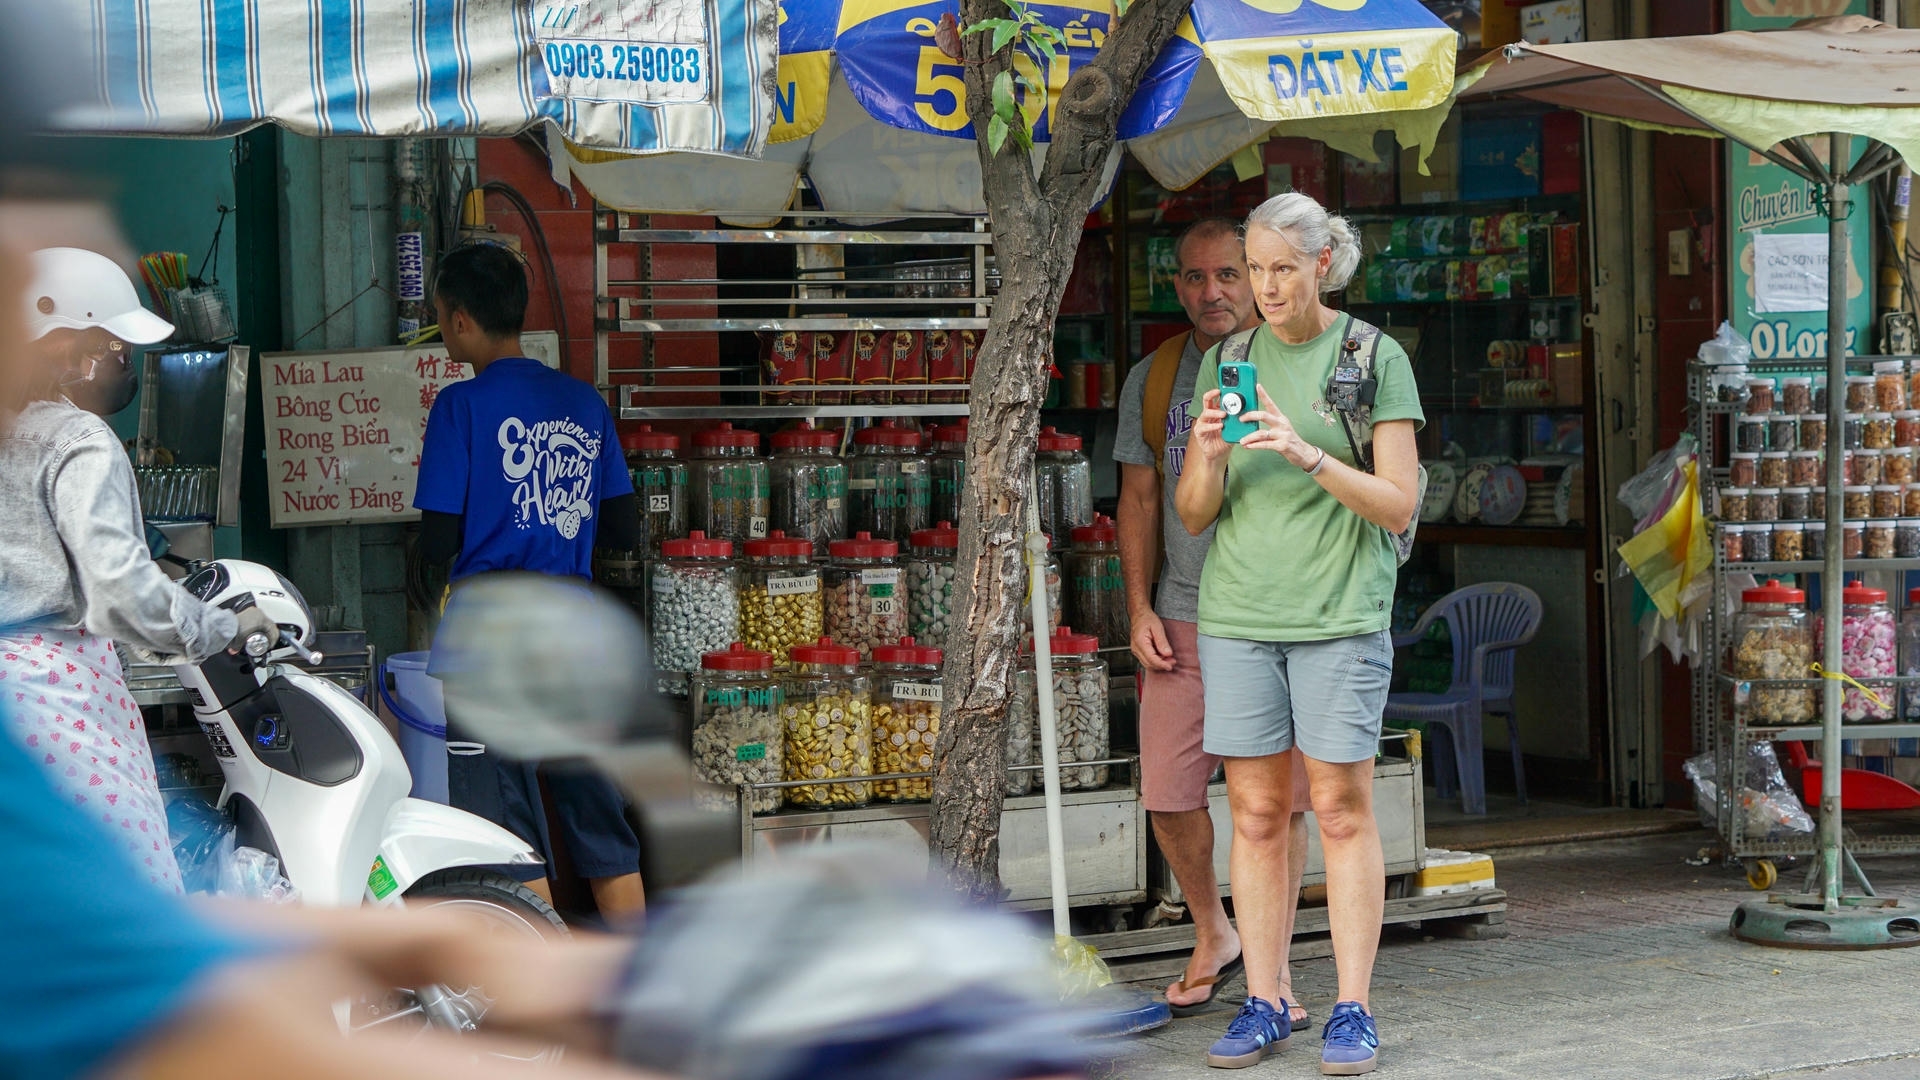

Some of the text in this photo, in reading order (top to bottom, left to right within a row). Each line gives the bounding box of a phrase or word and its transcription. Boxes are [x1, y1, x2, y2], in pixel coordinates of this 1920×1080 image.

[545, 43, 700, 83] 0903.259083
[1268, 39, 1408, 111] ĐẶT XE
[1740, 182, 1800, 225] Chuyên
[274, 360, 364, 386] Mía Lau
[276, 389, 381, 422] Bông Cúc
[278, 427, 334, 454] Rong
[342, 418, 390, 447] Biển
[282, 456, 342, 485] 24 Vị
[535, 450, 592, 489] With
[282, 482, 405, 512] Nước Đắng
[512, 463, 592, 525] Heart
[651, 497, 668, 510] 25
[753, 521, 765, 533] 40
[875, 600, 891, 613] 30
